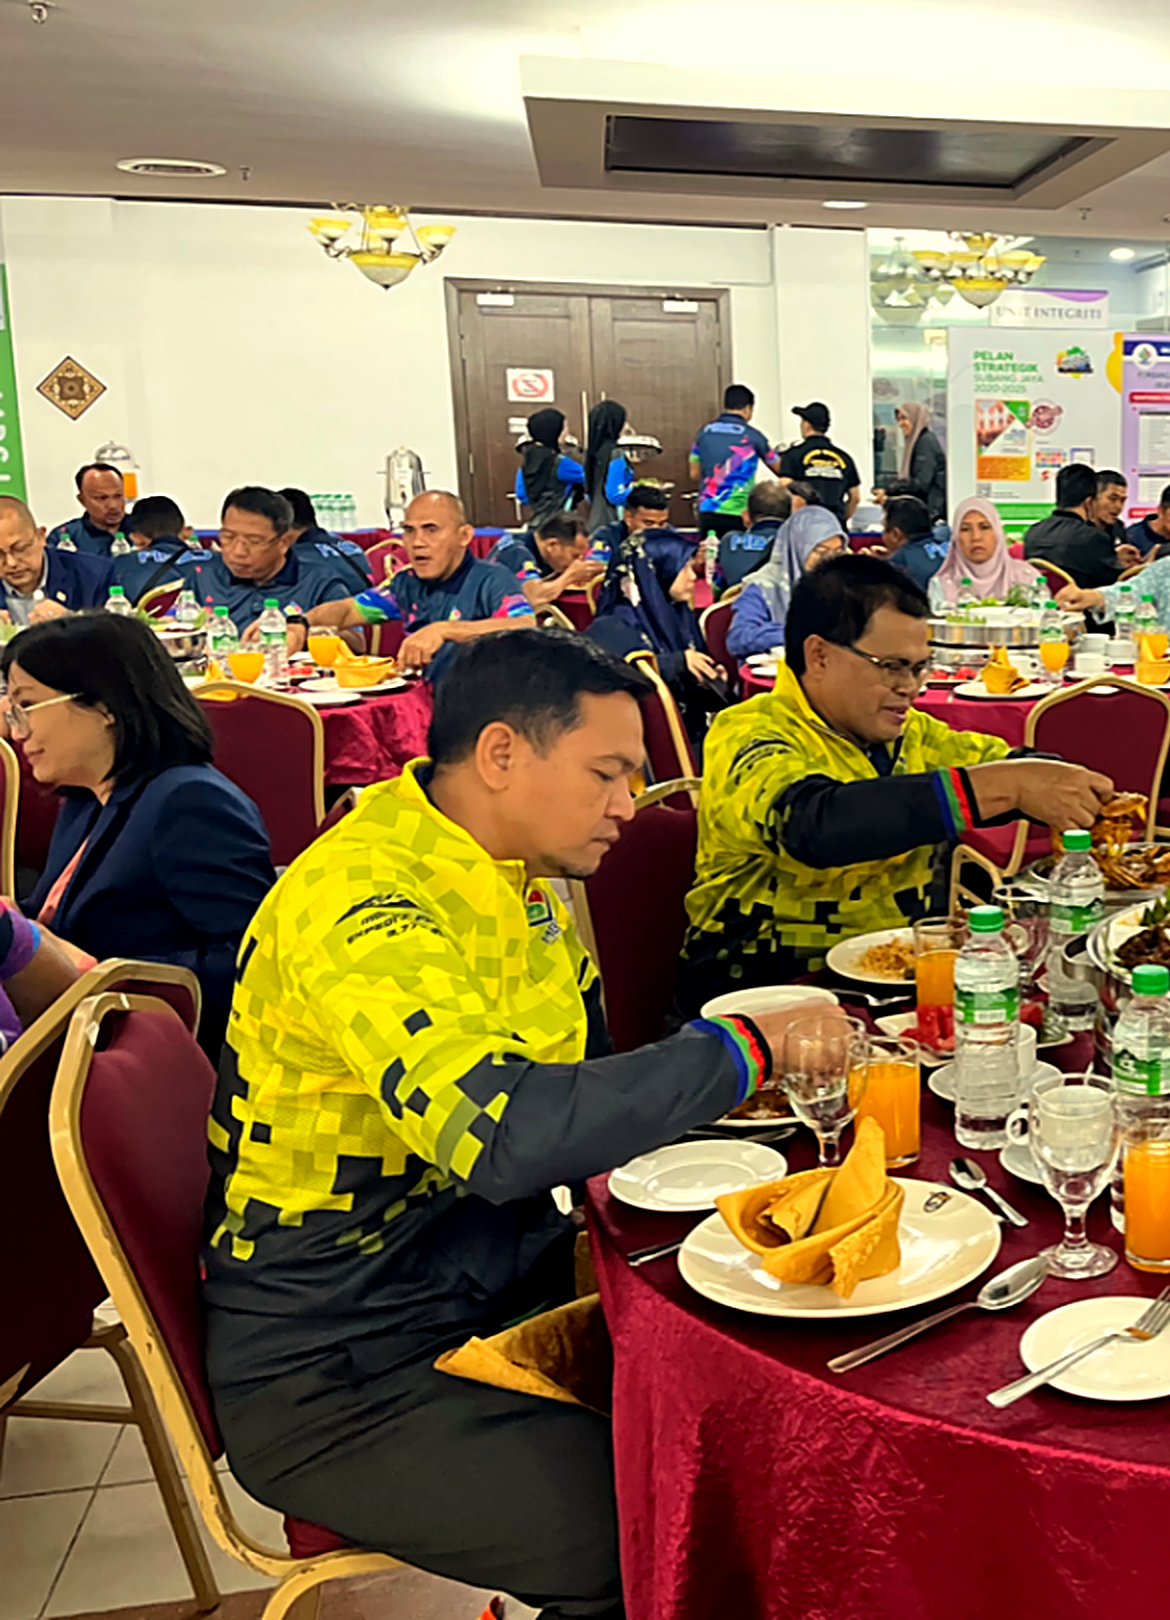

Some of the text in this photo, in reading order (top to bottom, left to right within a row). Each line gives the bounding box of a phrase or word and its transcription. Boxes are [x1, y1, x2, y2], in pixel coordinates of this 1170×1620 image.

[996, 306, 1102, 319] UNT INTEGRITI
[973, 350, 1014, 360] PELAN
[973, 362, 1038, 373] STRATEGIK
[973, 373, 1044, 383] SUBANG JAYA
